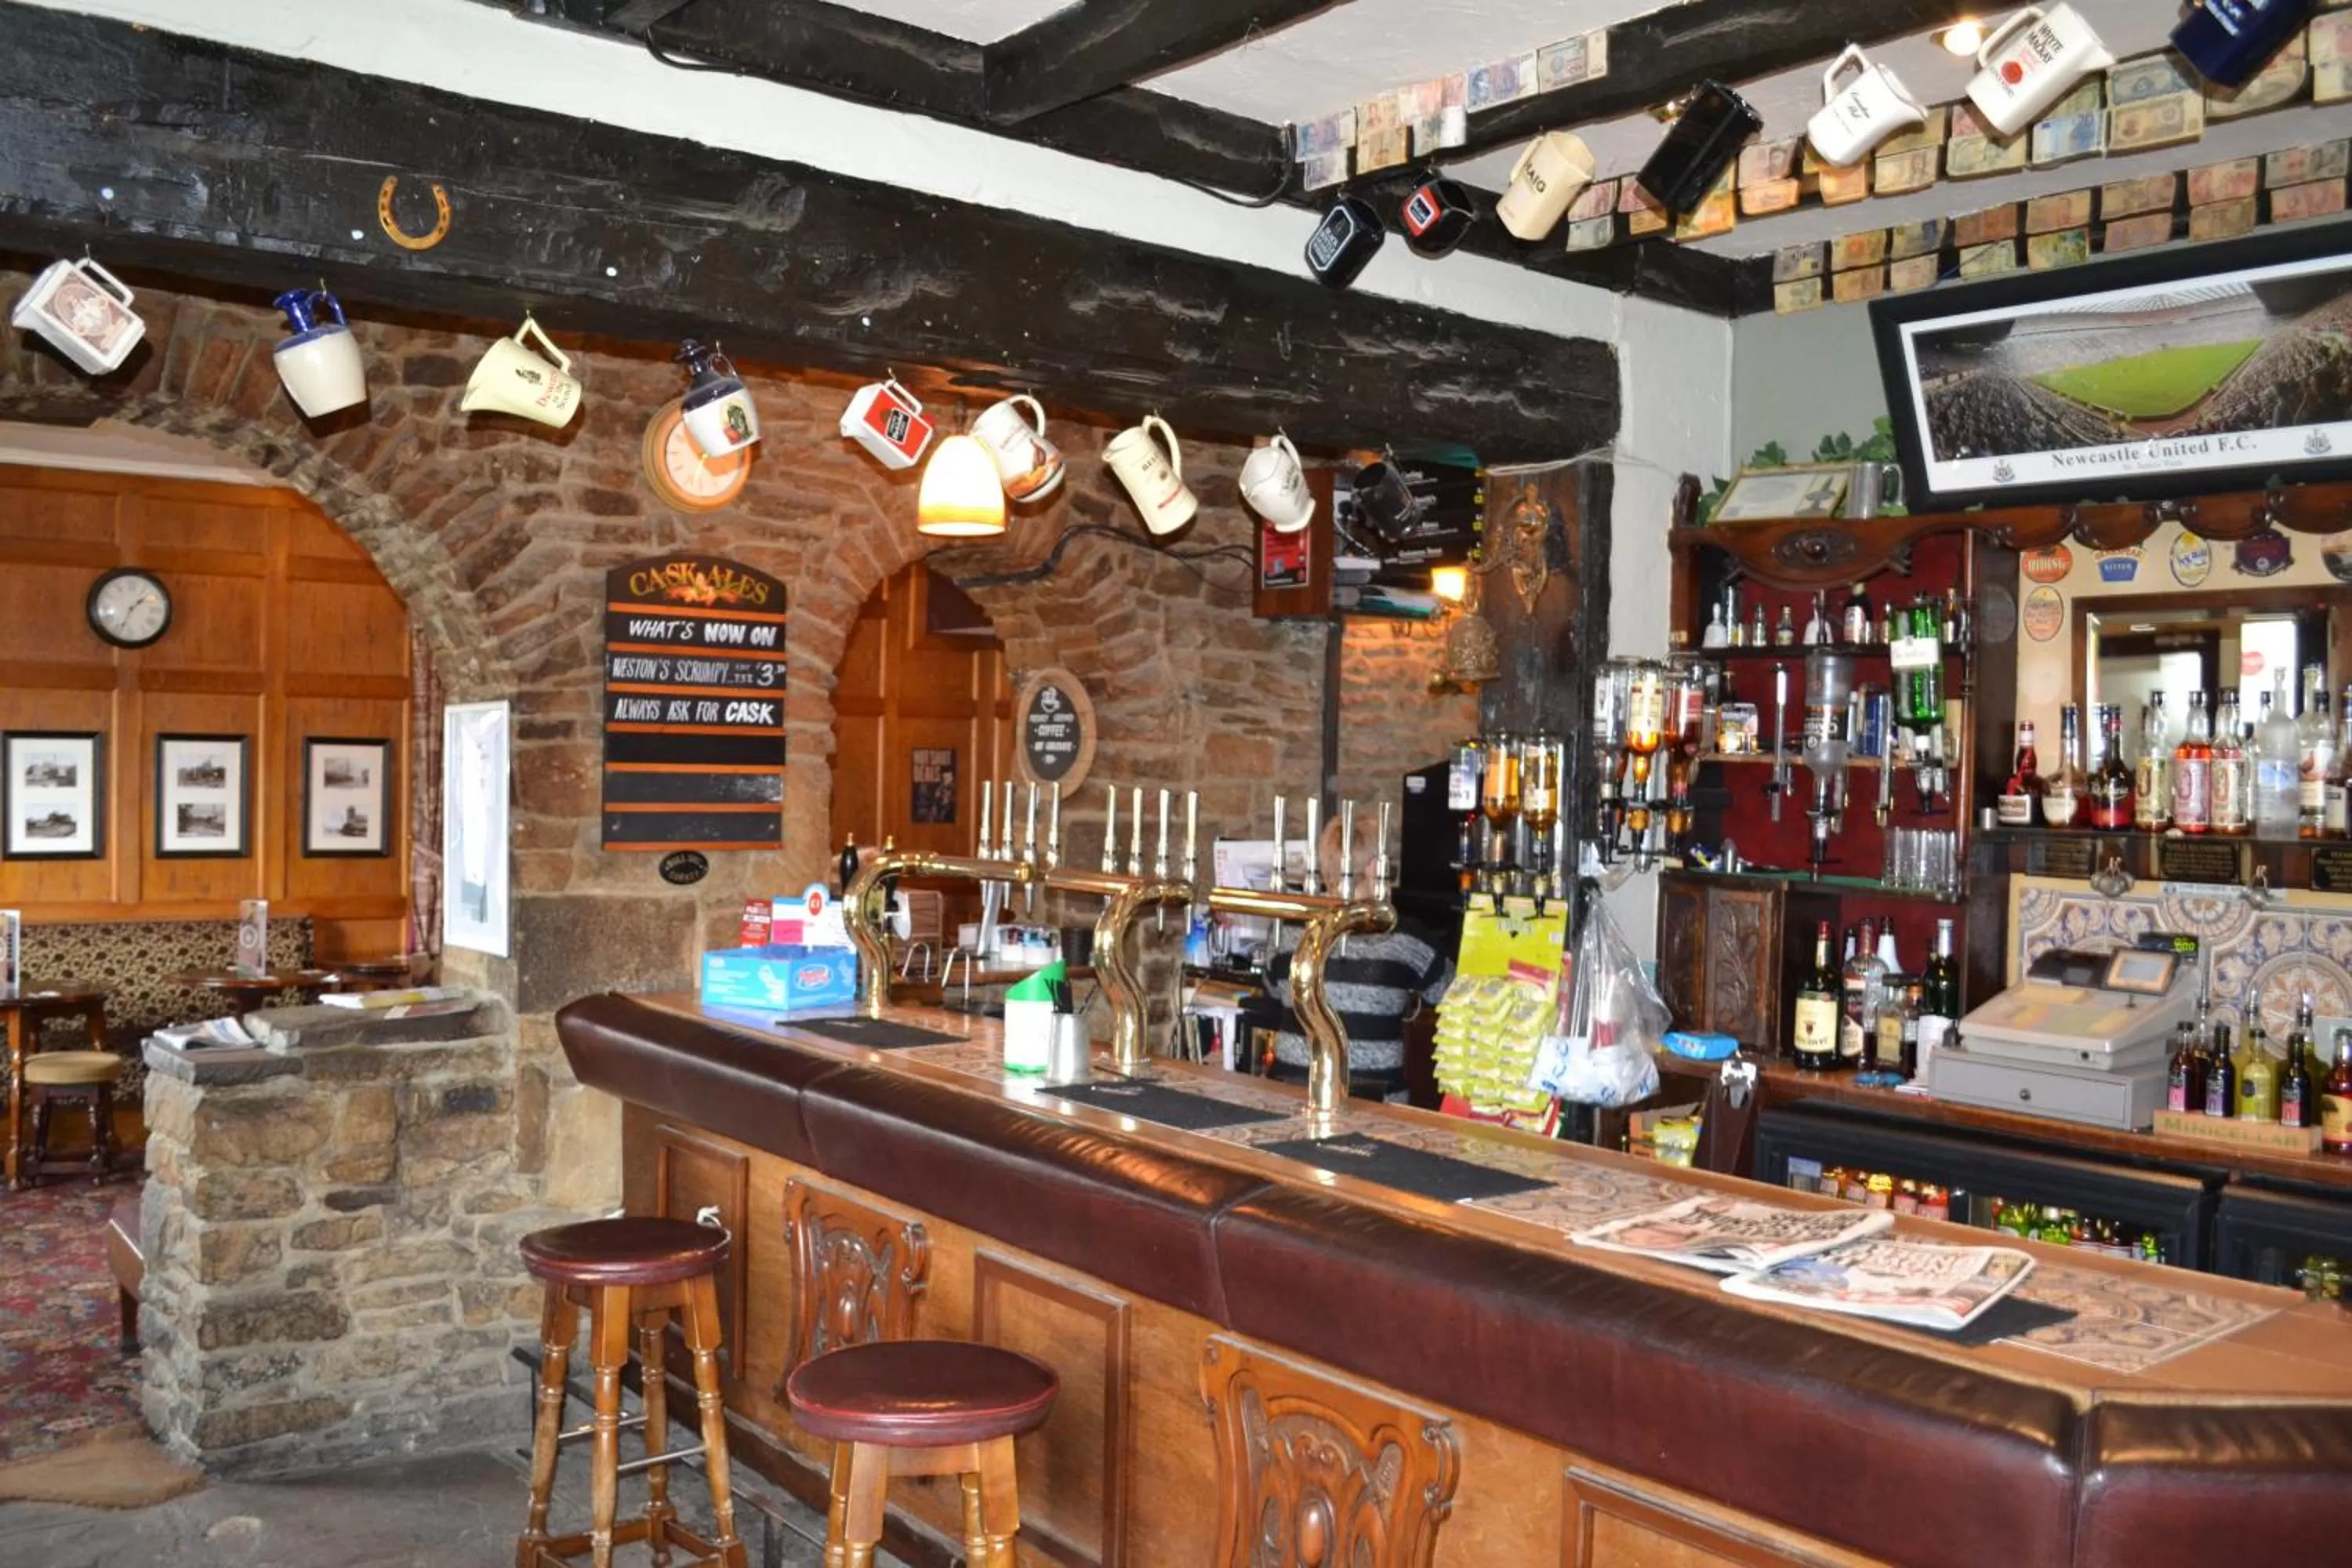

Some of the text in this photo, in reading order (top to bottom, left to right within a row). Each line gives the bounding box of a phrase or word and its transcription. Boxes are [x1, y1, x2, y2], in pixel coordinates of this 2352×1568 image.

[2038, 22, 2064, 53] WHYTE
[2051, 446, 2140, 468] Newcastle
[2147, 437, 2209, 459] United
[2217, 435, 2258, 452] F.C.
[629, 561, 769, 605] CASK ALES
[629, 619, 778, 647] WHAT'S NOW ON
[614, 697, 775, 725] ALWAYS ASK FOR CASK
